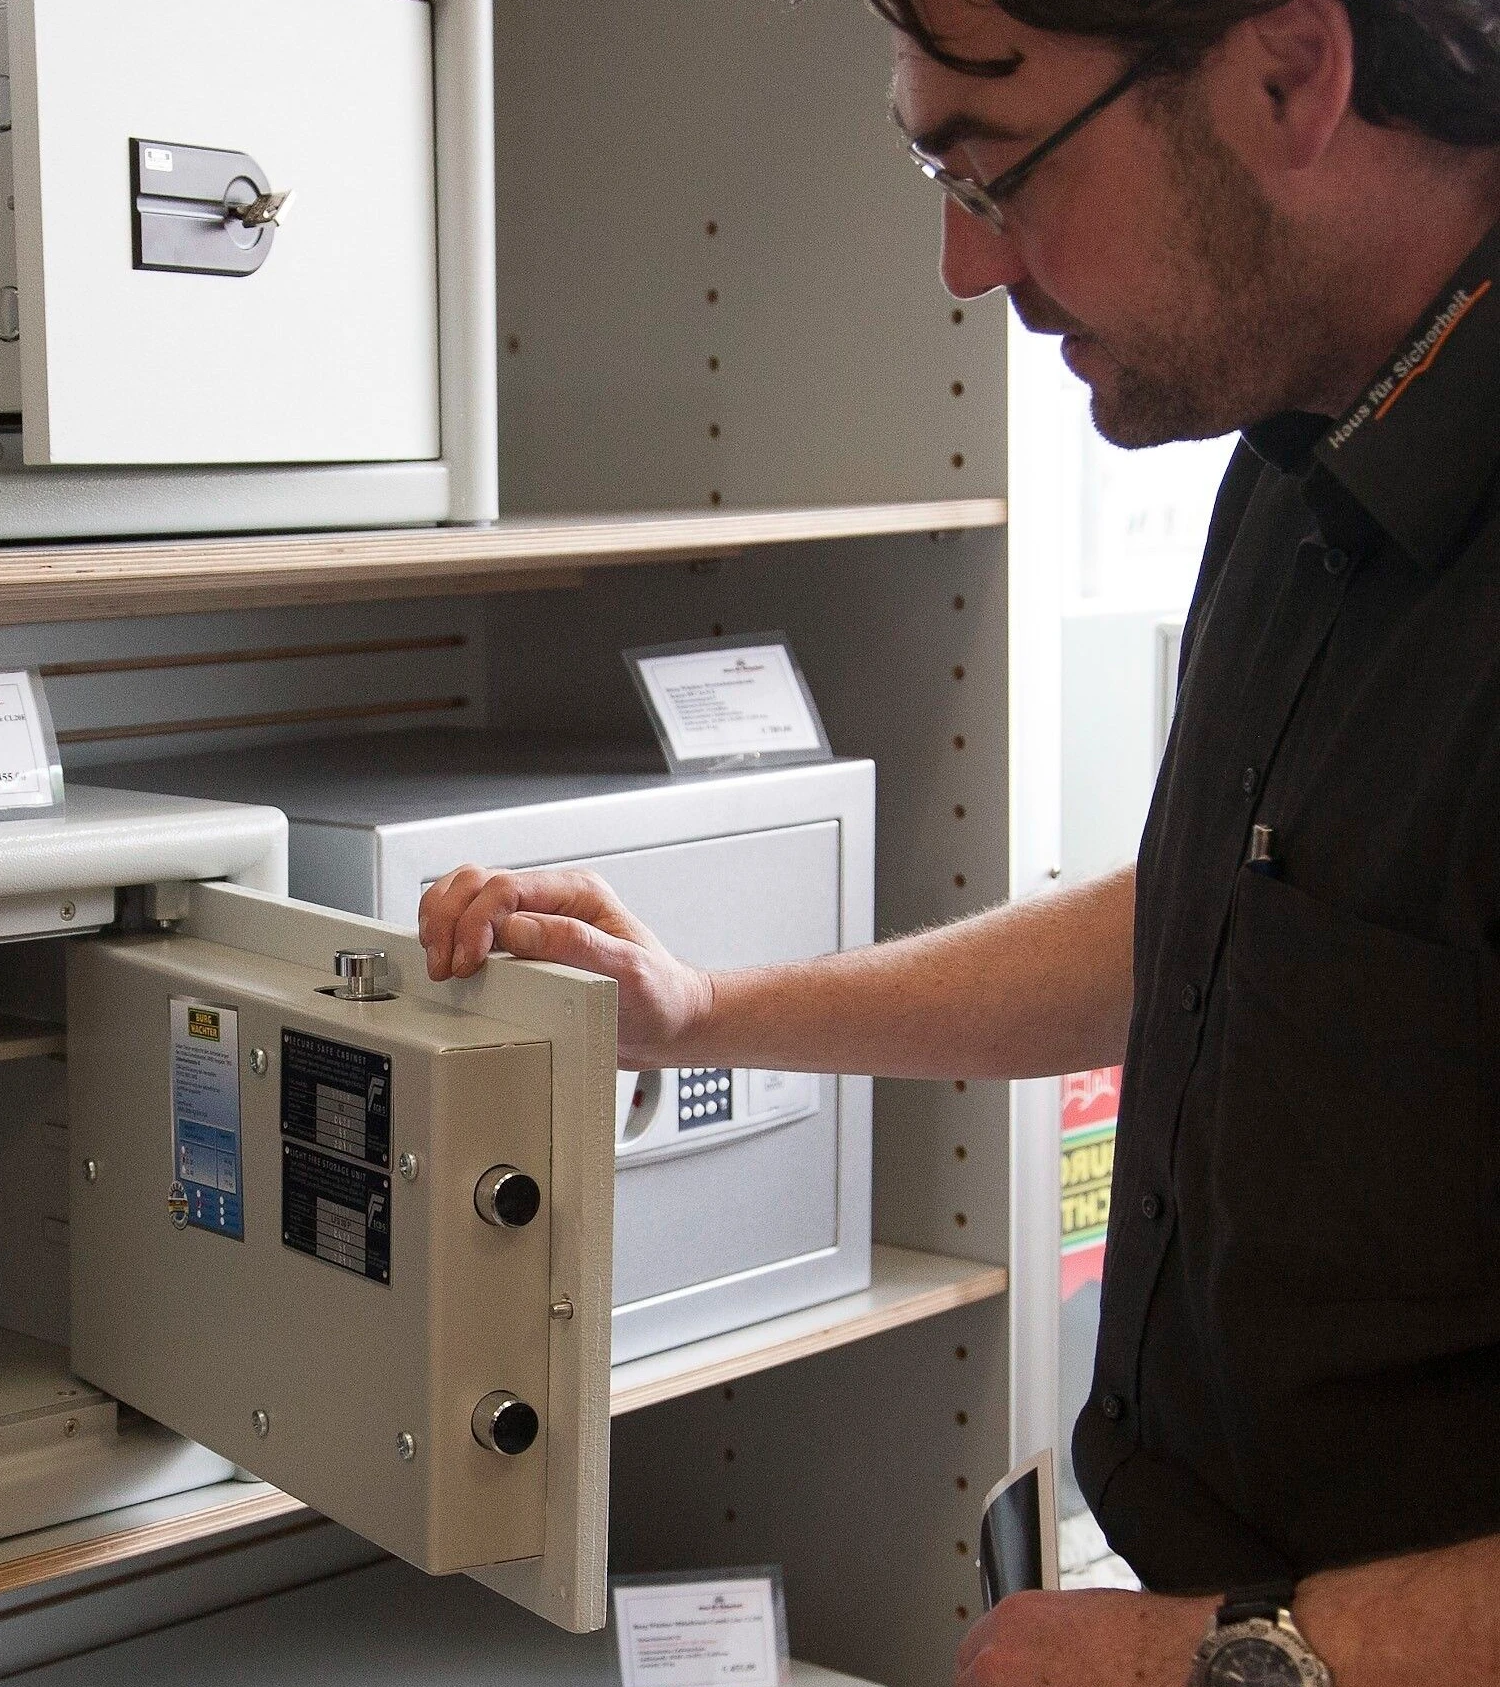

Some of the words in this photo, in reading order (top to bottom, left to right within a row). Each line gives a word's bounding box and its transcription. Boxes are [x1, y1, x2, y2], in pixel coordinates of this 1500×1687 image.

[1328, 404, 1371, 449] Haus
[1393, 289, 1470, 378] Sicherheit
[195, 1012, 212, 1025] BURG
[317, 1043, 333, 1056] SAFE
[336, 1049, 367, 1065] CABINET
[322, 1160, 349, 1177] STORAGE
